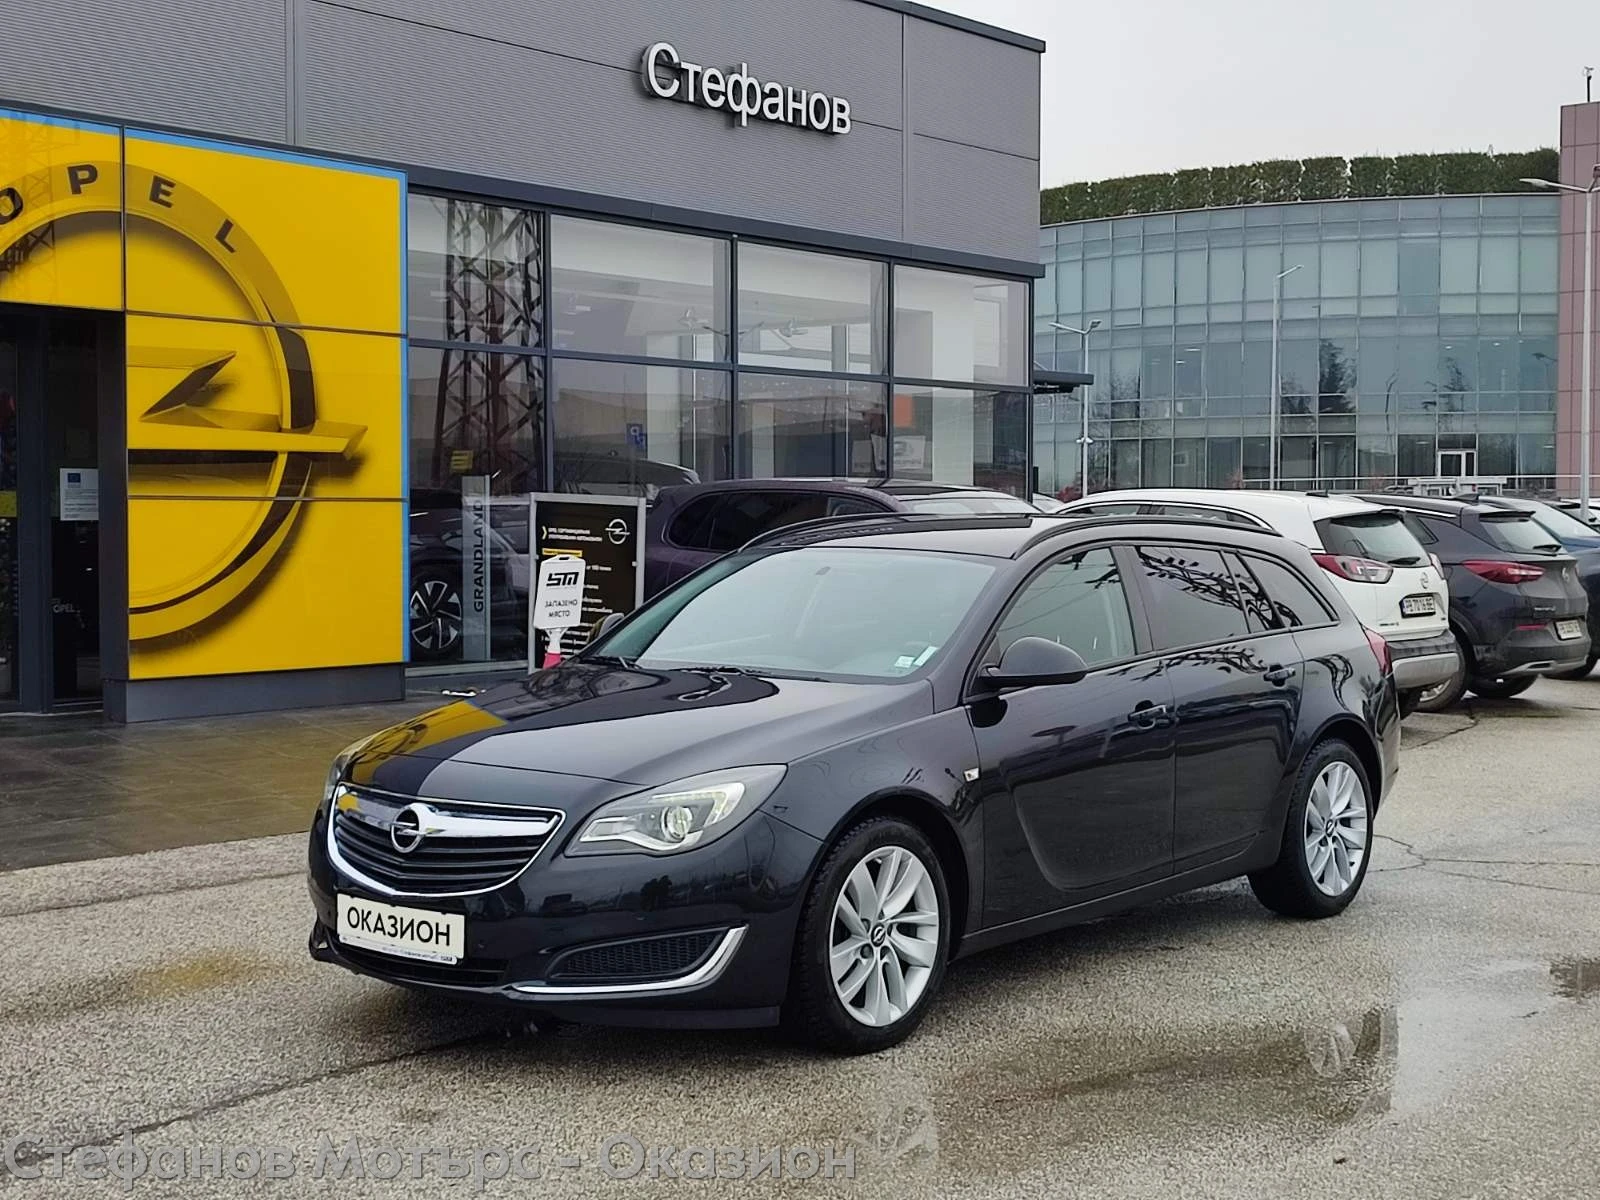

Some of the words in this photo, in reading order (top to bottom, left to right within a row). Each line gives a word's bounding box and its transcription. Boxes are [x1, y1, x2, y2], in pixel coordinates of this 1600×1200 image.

[645, 41, 851, 135] Стефанов
[0, 163, 238, 254] OPEL
[473, 500, 484, 613] GRANDLAND
[347, 906, 450, 947] ОКАЗИОН
